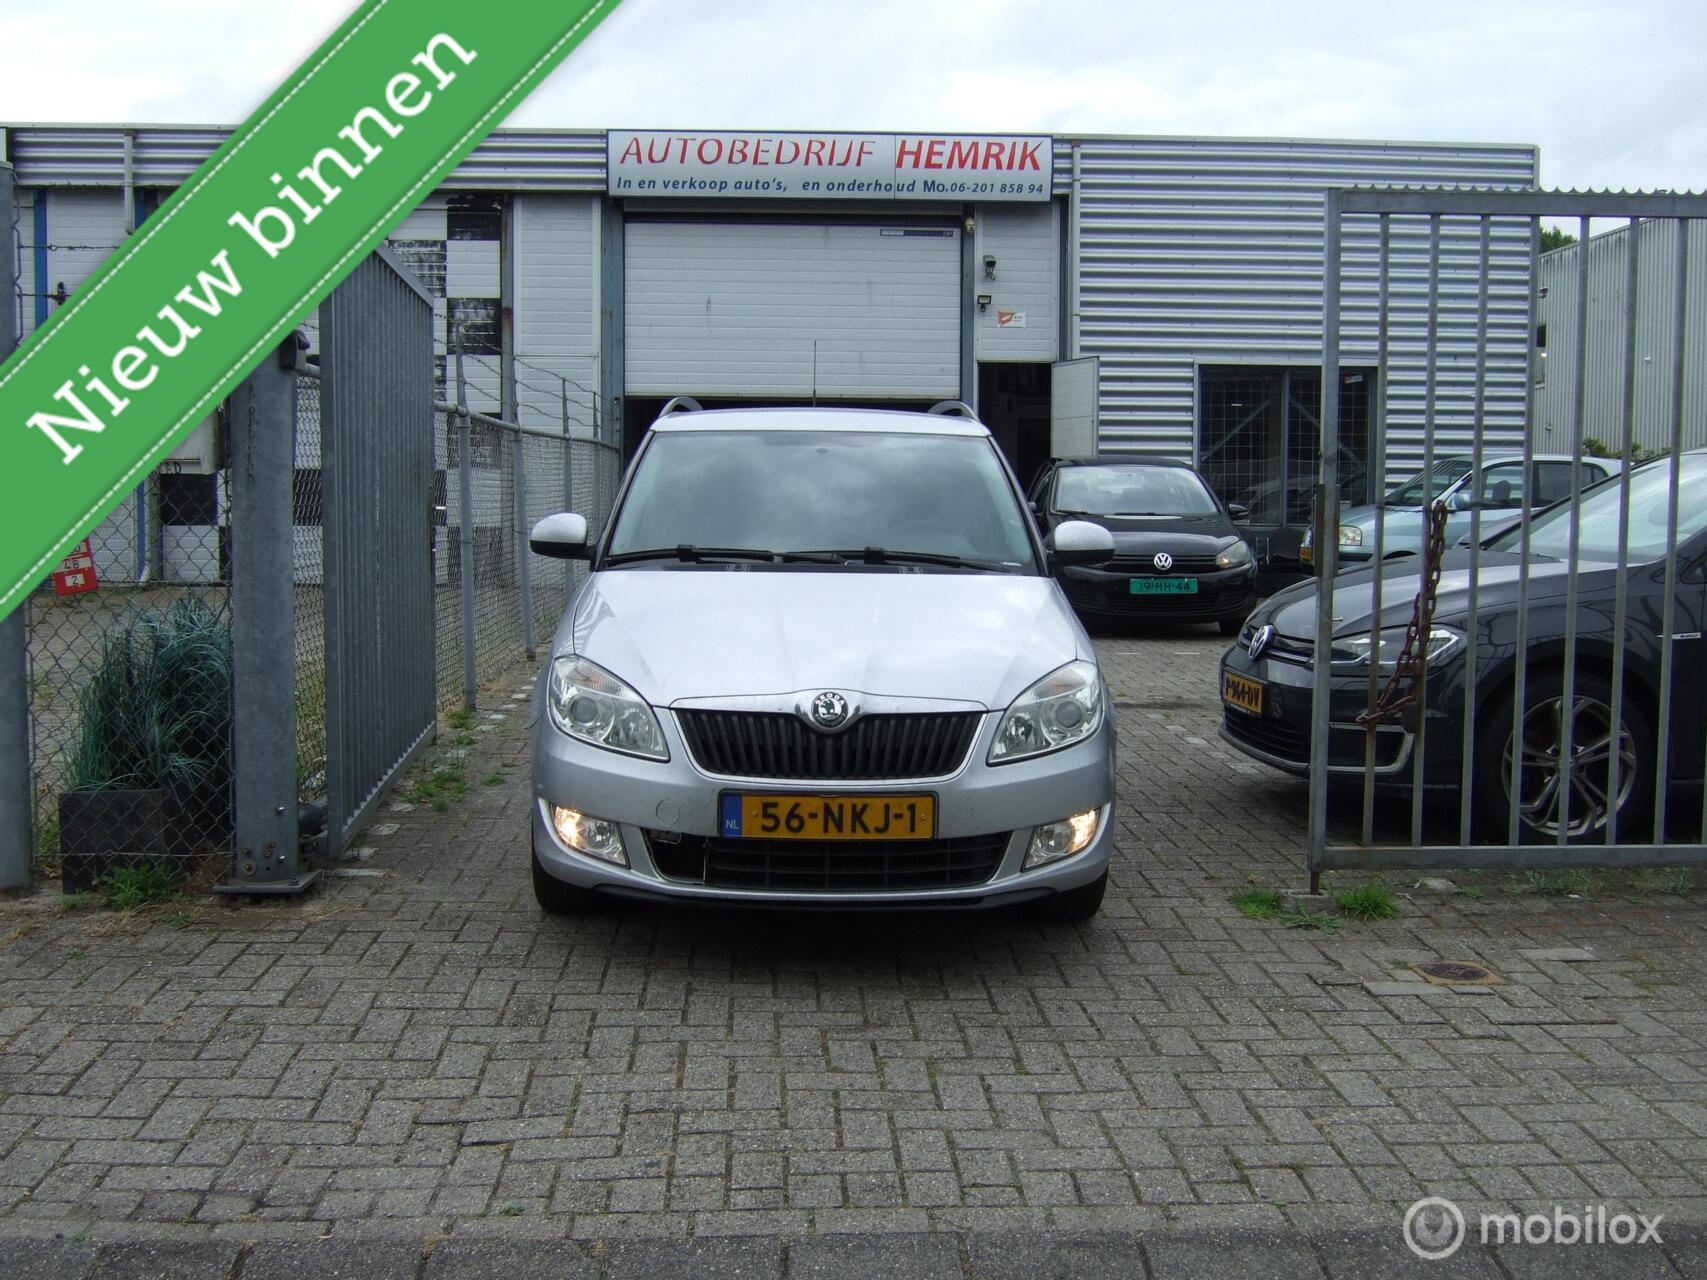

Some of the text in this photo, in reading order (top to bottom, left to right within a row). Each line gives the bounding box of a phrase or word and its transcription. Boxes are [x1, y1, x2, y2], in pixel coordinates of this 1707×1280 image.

[619, 137, 1044, 171] AUTOBEDRIJF HEMRIK
[617, 177, 632, 189] In
[638, 179, 656, 189] en
[662, 177, 728, 192] verkoop
[802, 181, 820, 191] en
[826, 179, 916, 192] onderhoud
[1000, 183, 1023, 194] 858
[1028, 183, 1044, 194] 94
[725, 819, 740, 830] NL
[761, 802, 917, 834] 56-NKJ-1
